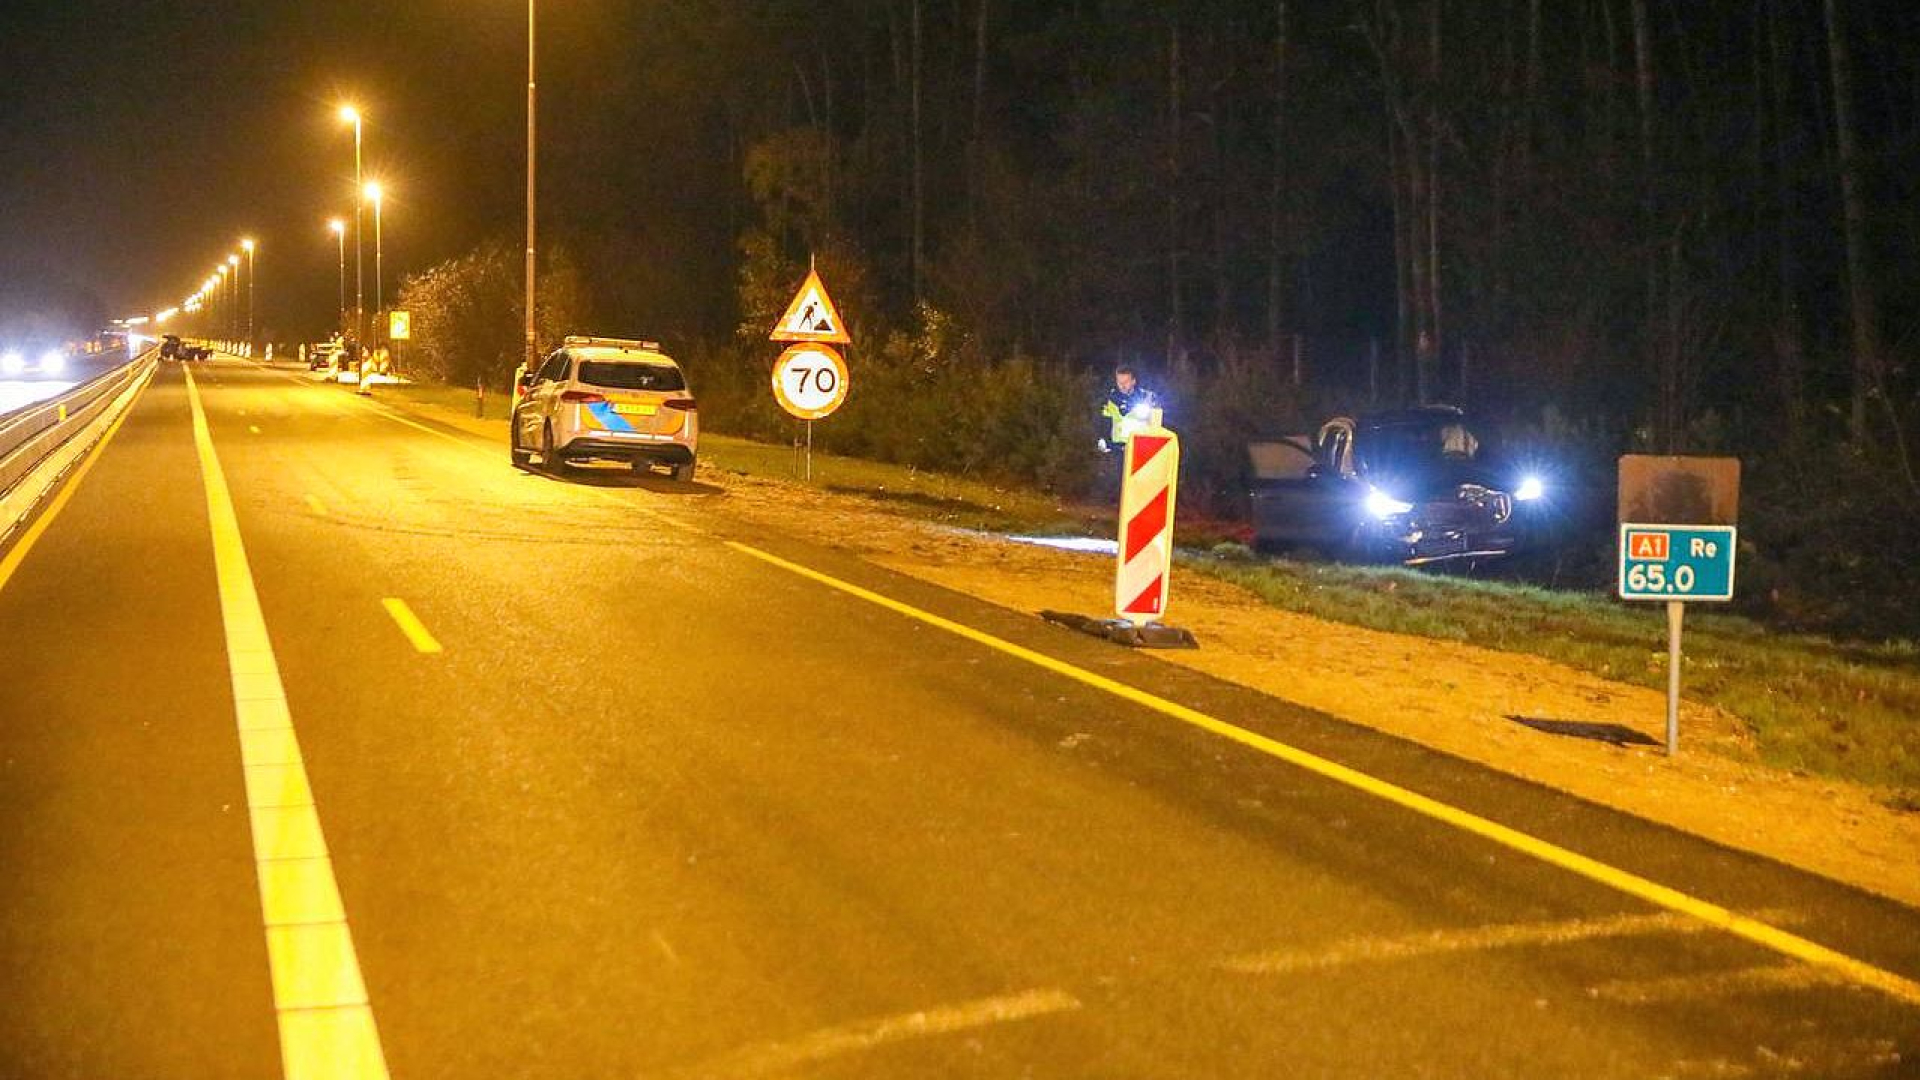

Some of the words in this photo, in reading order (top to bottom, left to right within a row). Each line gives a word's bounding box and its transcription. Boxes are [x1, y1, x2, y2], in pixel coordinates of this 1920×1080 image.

[791, 368, 835, 393] 70
[1639, 537, 1661, 555] A1
[1690, 538, 1717, 558] Re
[1628, 564, 1695, 592] 65.0
